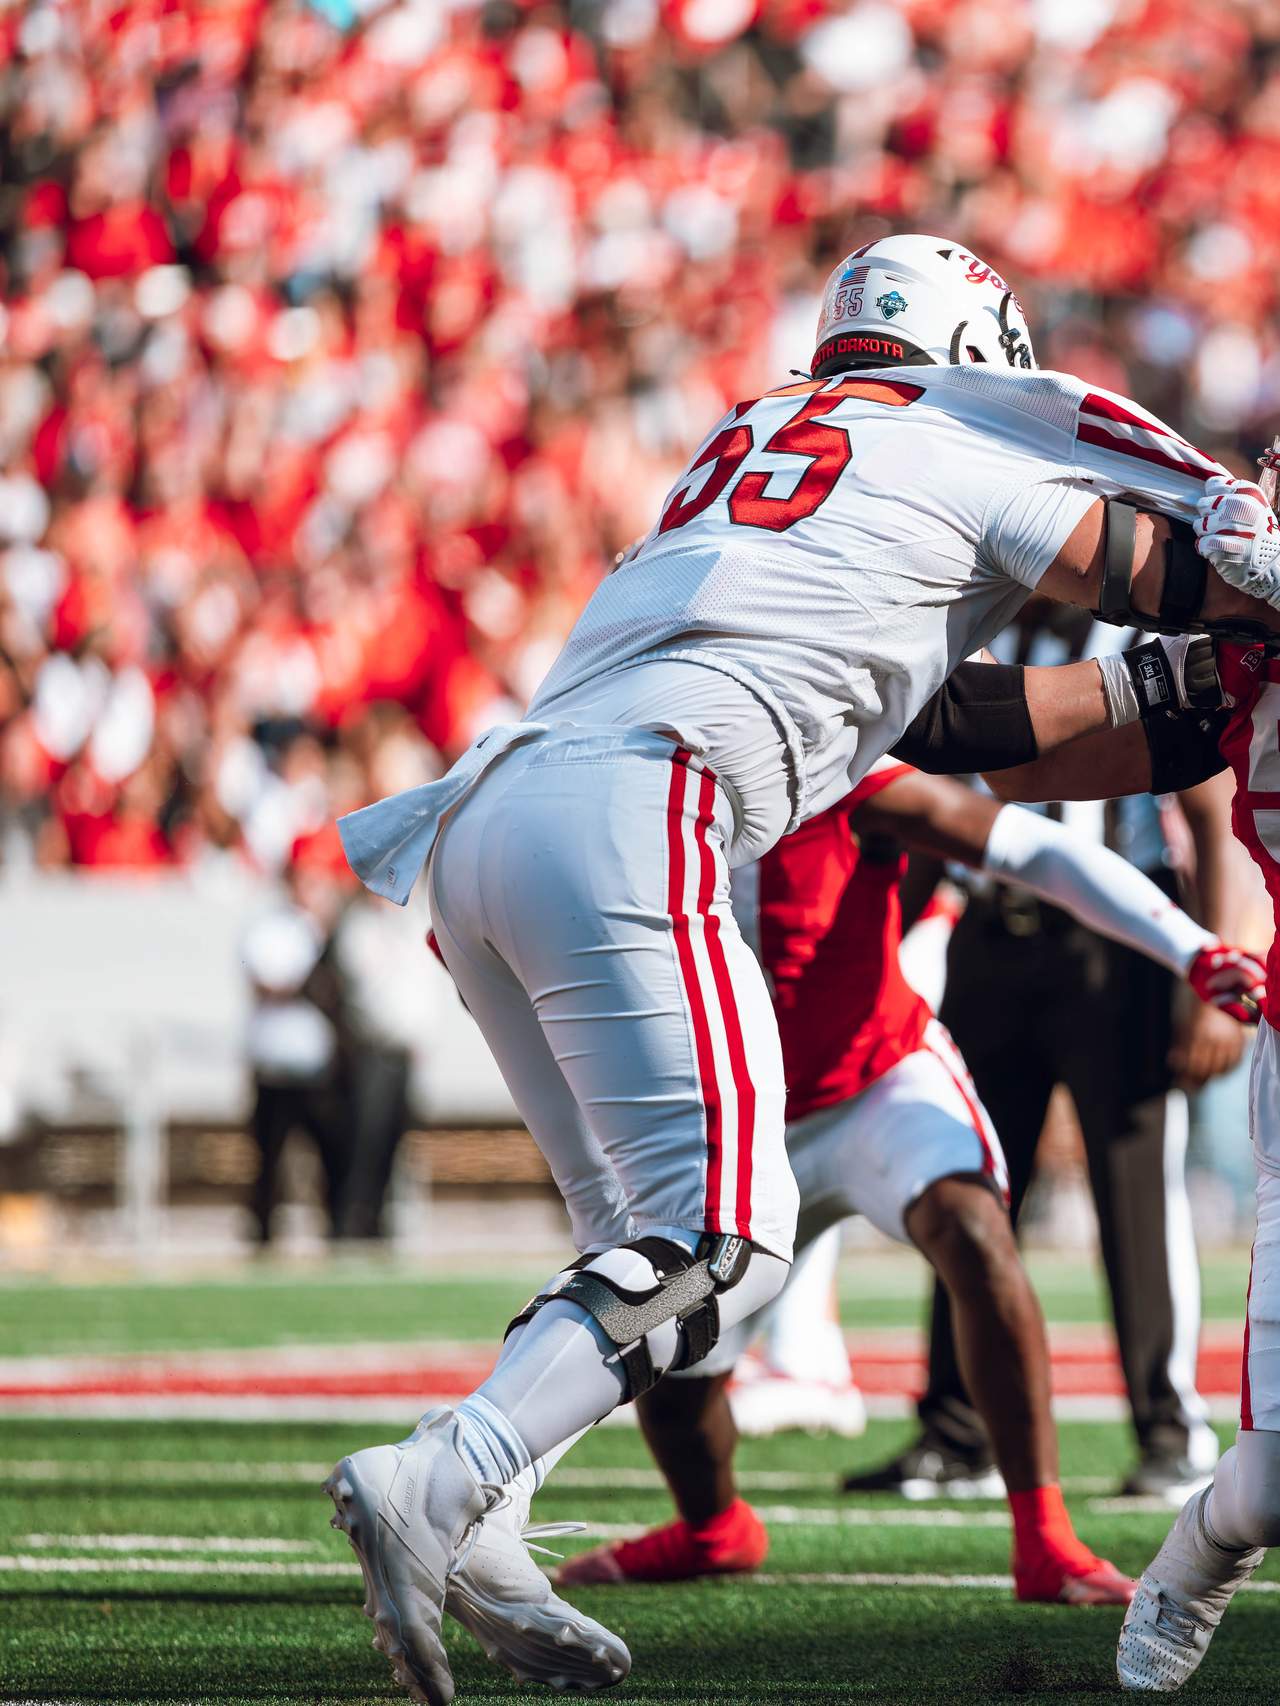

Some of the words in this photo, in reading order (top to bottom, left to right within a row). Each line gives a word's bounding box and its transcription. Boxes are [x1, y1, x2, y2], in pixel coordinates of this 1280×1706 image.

[833, 288, 864, 320] 55
[837, 337, 904, 360] DAKOTA
[657, 376, 927, 537] 55
[1143, 663, 1155, 679] 3XL
